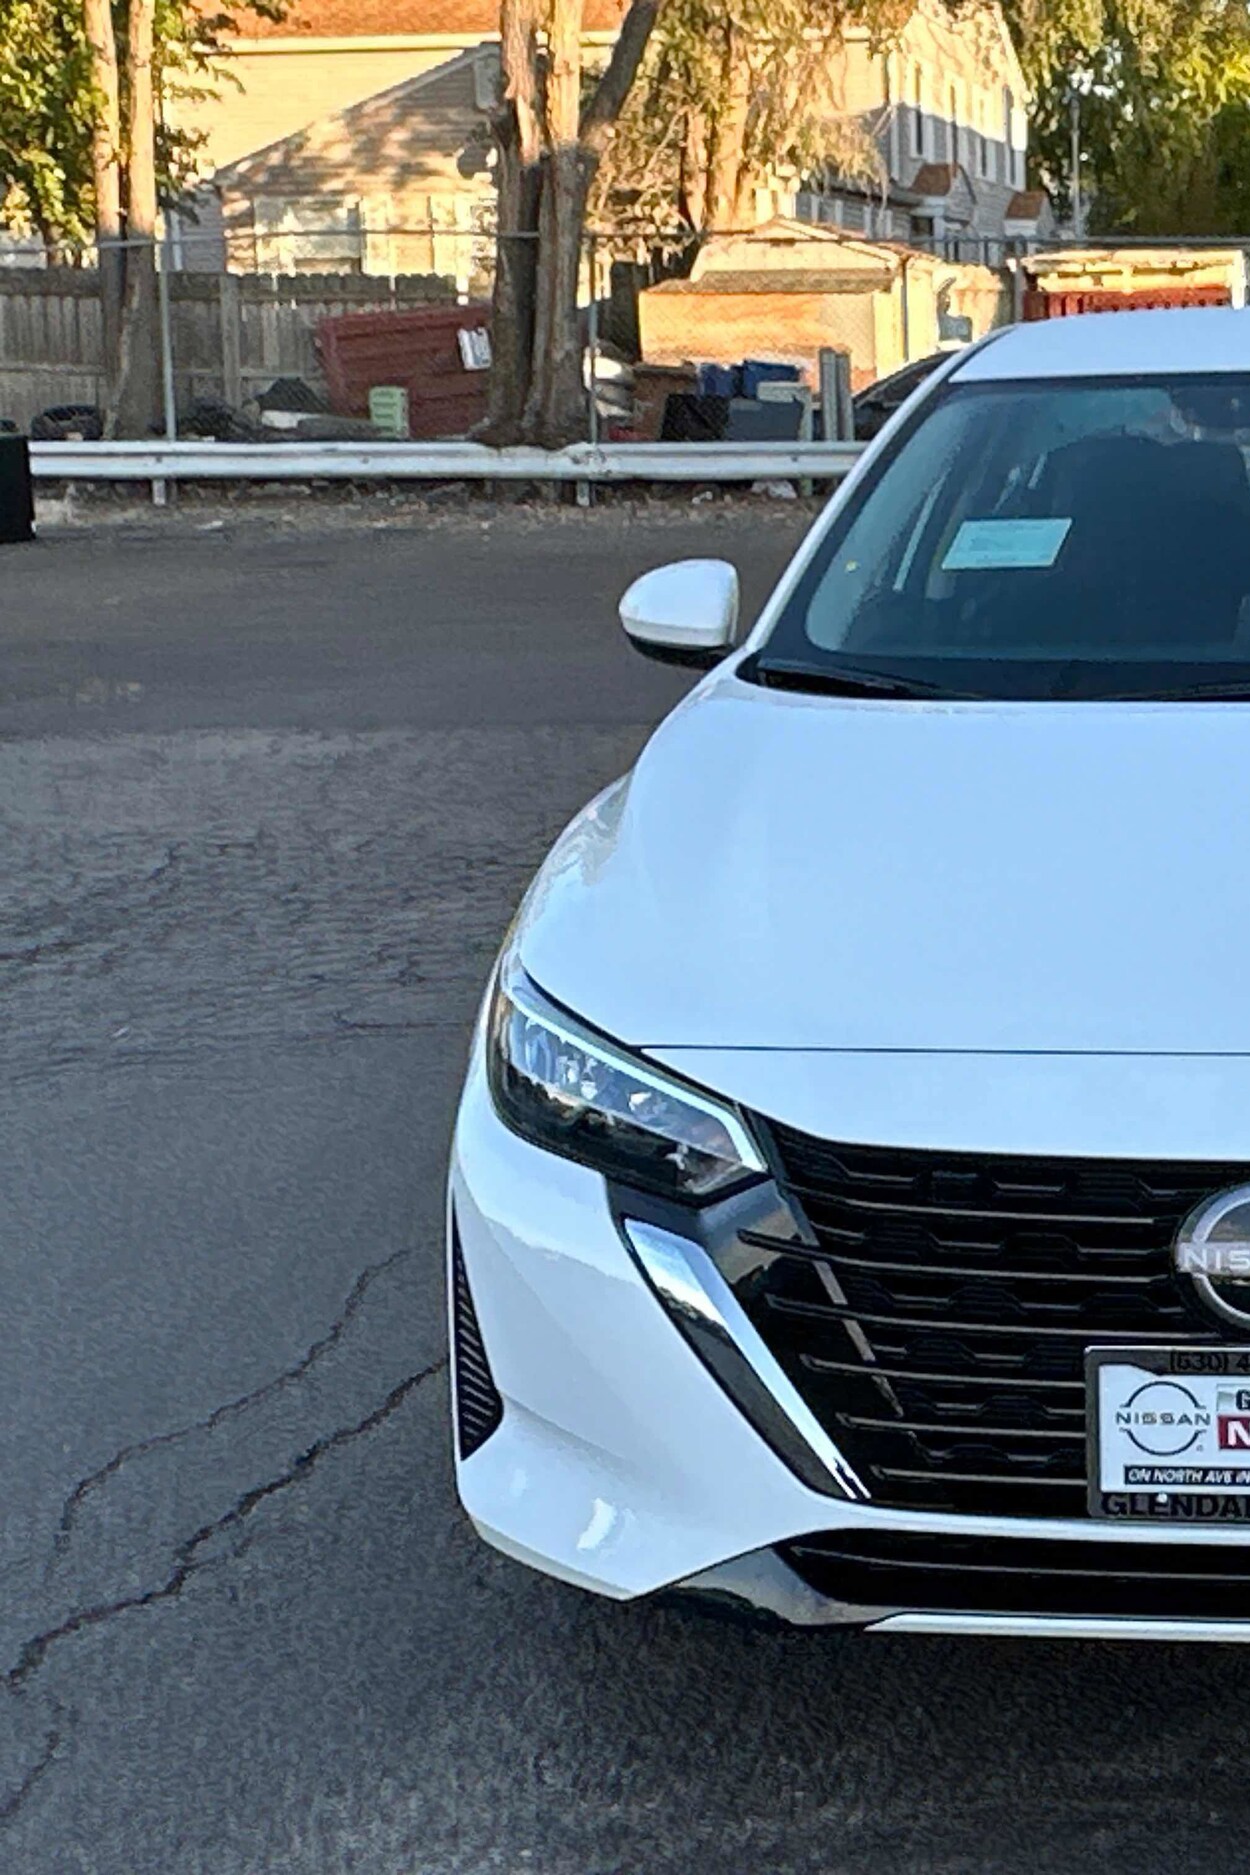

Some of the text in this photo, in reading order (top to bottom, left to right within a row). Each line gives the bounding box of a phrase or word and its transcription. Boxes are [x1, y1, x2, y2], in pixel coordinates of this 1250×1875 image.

[1115, 1411, 1211, 1426] NISSAN
[1128, 1468, 1151, 1482] ON
[1153, 1468, 1203, 1483] NORTH
